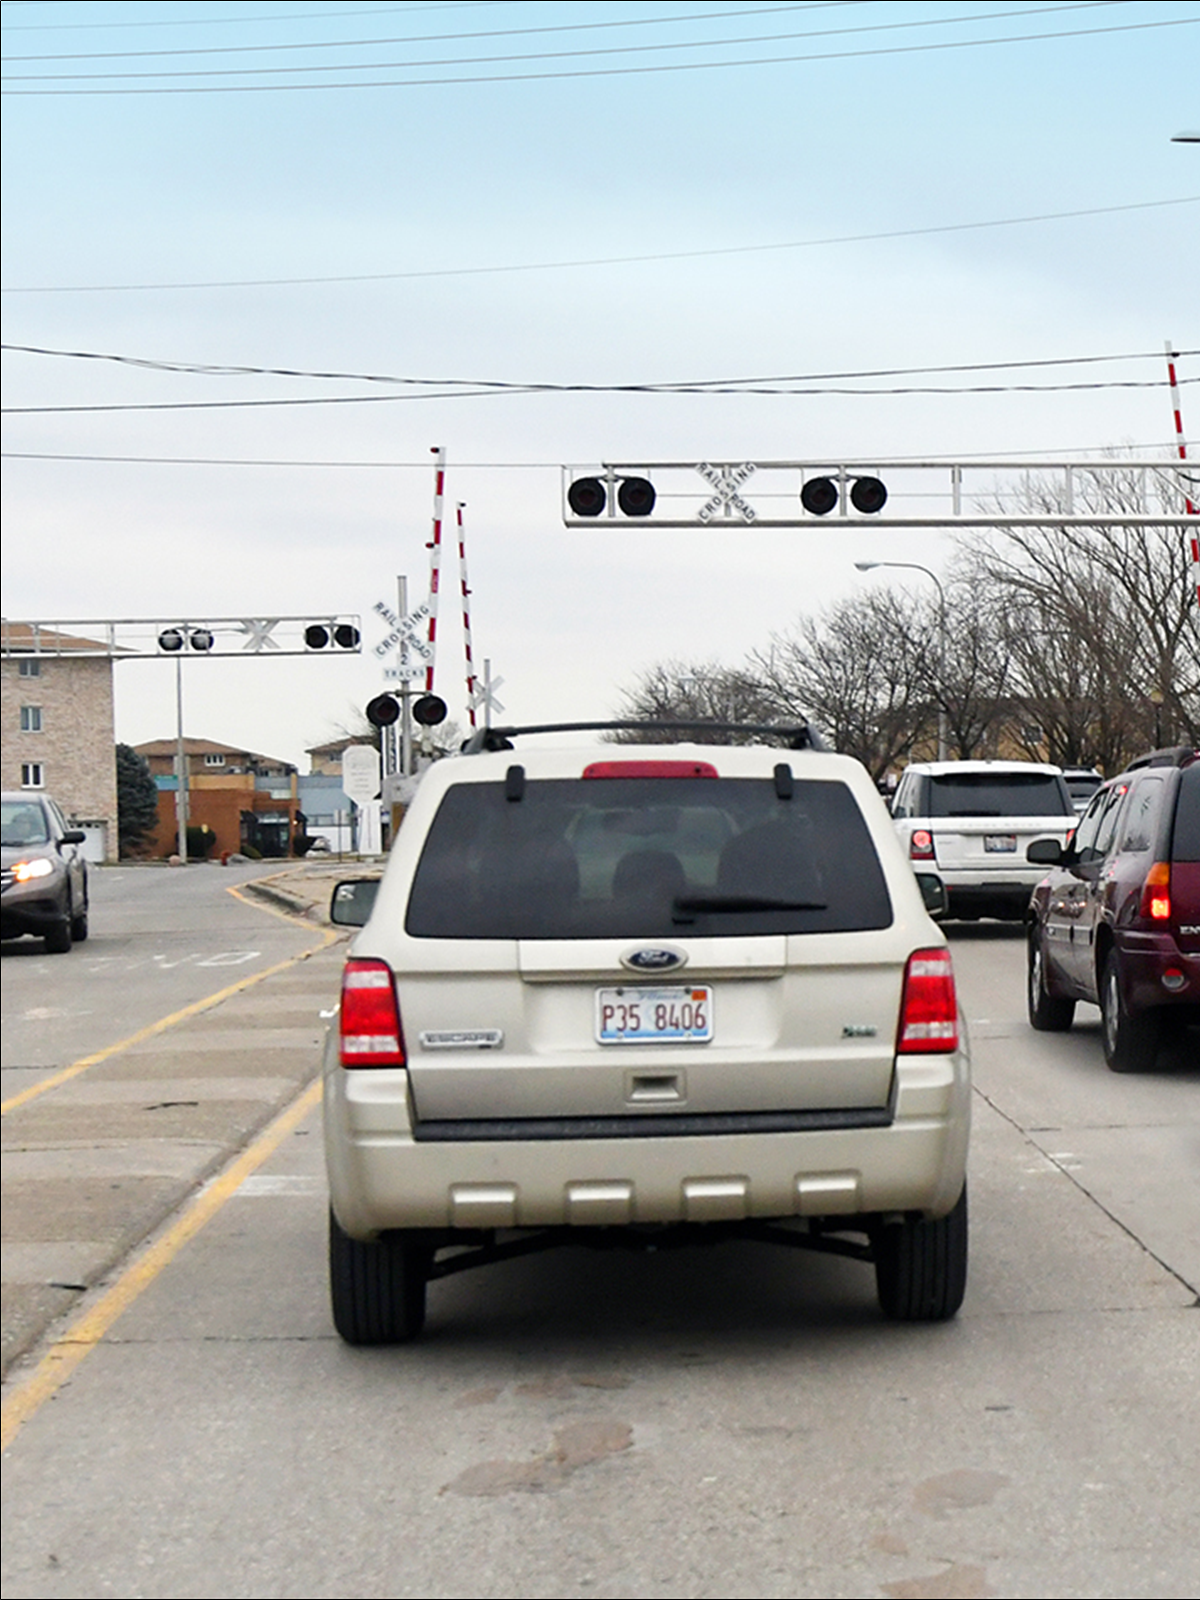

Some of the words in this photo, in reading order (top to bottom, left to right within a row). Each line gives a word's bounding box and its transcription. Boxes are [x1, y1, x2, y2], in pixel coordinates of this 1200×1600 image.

[698, 461, 755, 520] CROSSING
[698, 462, 722, 490] RAIL
[730, 493, 755, 520] ROAD
[374, 601, 397, 627] RAIL
[407, 633, 431, 659] ROAD
[375, 605, 430, 656] CROSSING
[385, 669, 424, 678] TRACKS
[400, 653, 408, 666] 2
[602, 1004, 641, 1032] P35
[655, 1002, 706, 1031] 8406
